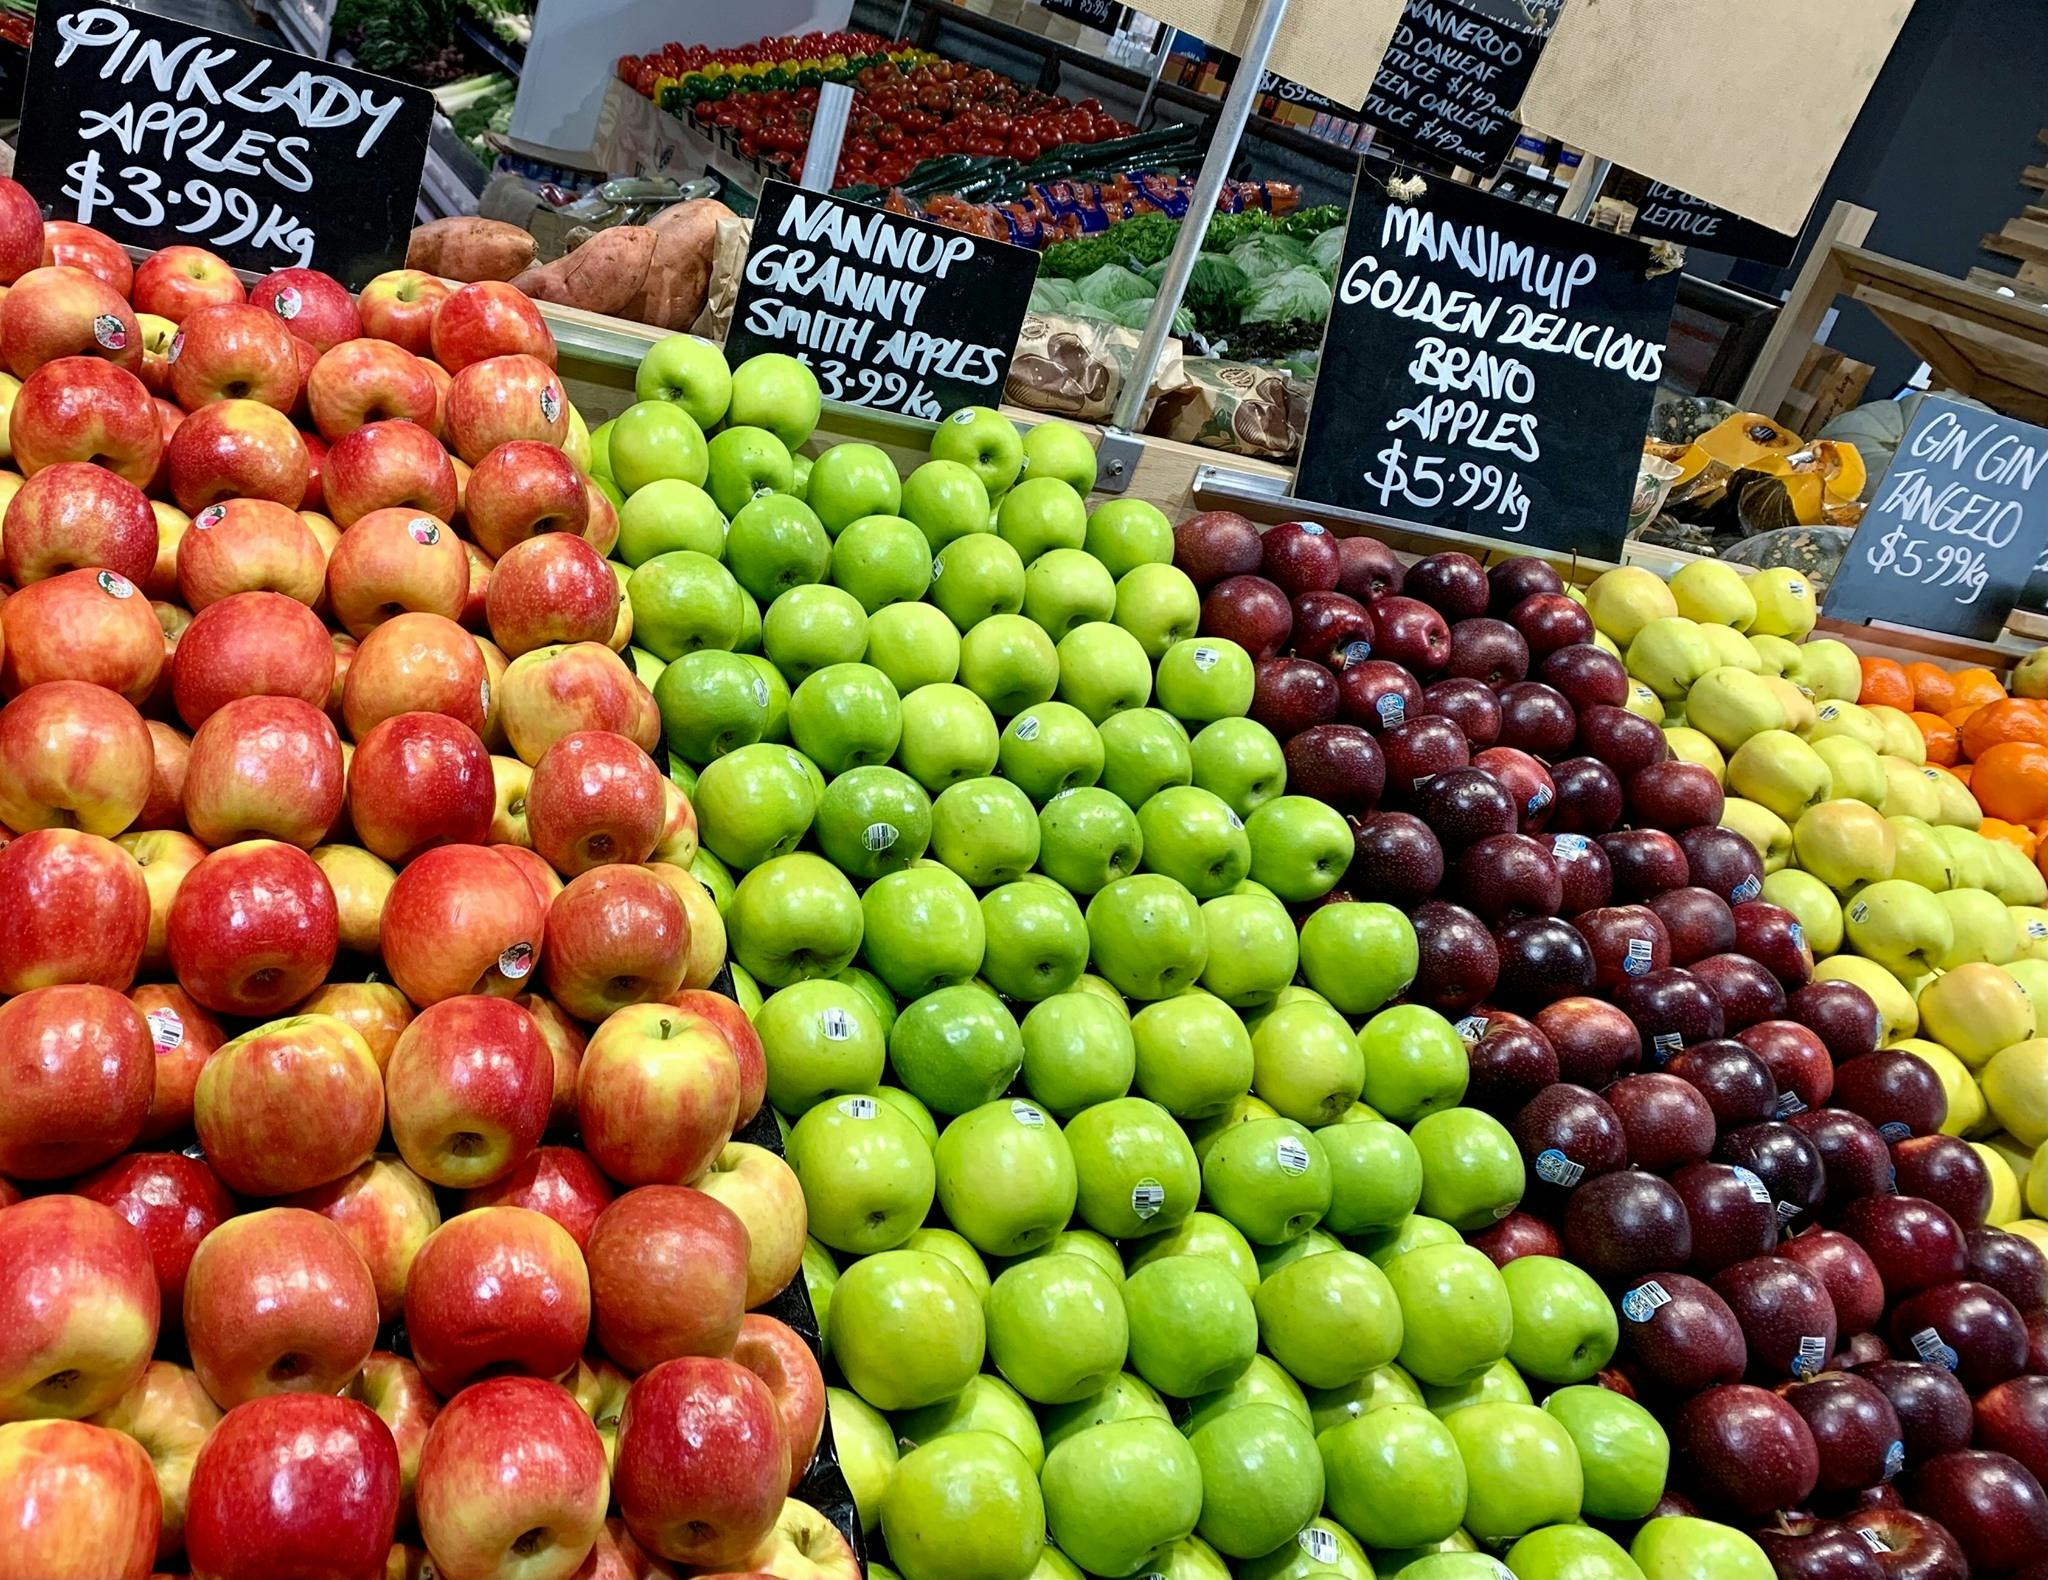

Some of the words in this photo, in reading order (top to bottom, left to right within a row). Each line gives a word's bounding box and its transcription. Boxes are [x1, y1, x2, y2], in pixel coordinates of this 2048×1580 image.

[1403, 0, 1523, 66] WANNEROO
[1414, 37, 1502, 82] OAKLEAF
[56, 8, 237, 105] PINK
[222, 58, 405, 157] LADY
[1419, 93, 1503, 135] OAKLEAF
[79, 102, 313, 192] APPLES
[777, 194, 975, 279] NANNUP
[1381, 203, 1597, 309] MANJIMUP
[1641, 203, 1722, 236] LETTUCE
[746, 244, 926, 326] GRANNY
[1339, 255, 1502, 339] GOLDEN
[1497, 303, 1667, 382] DELICIOUS
[744, 298, 876, 361] SMITH
[872, 329, 1006, 386] APPLES
[1408, 337, 1535, 404] BRAVO
[1386, 396, 1540, 463] APPLES
[1911, 412, 1999, 470] GIN
[1975, 434, 2048, 490] GIN
[1878, 468, 2023, 549] TANGELO
